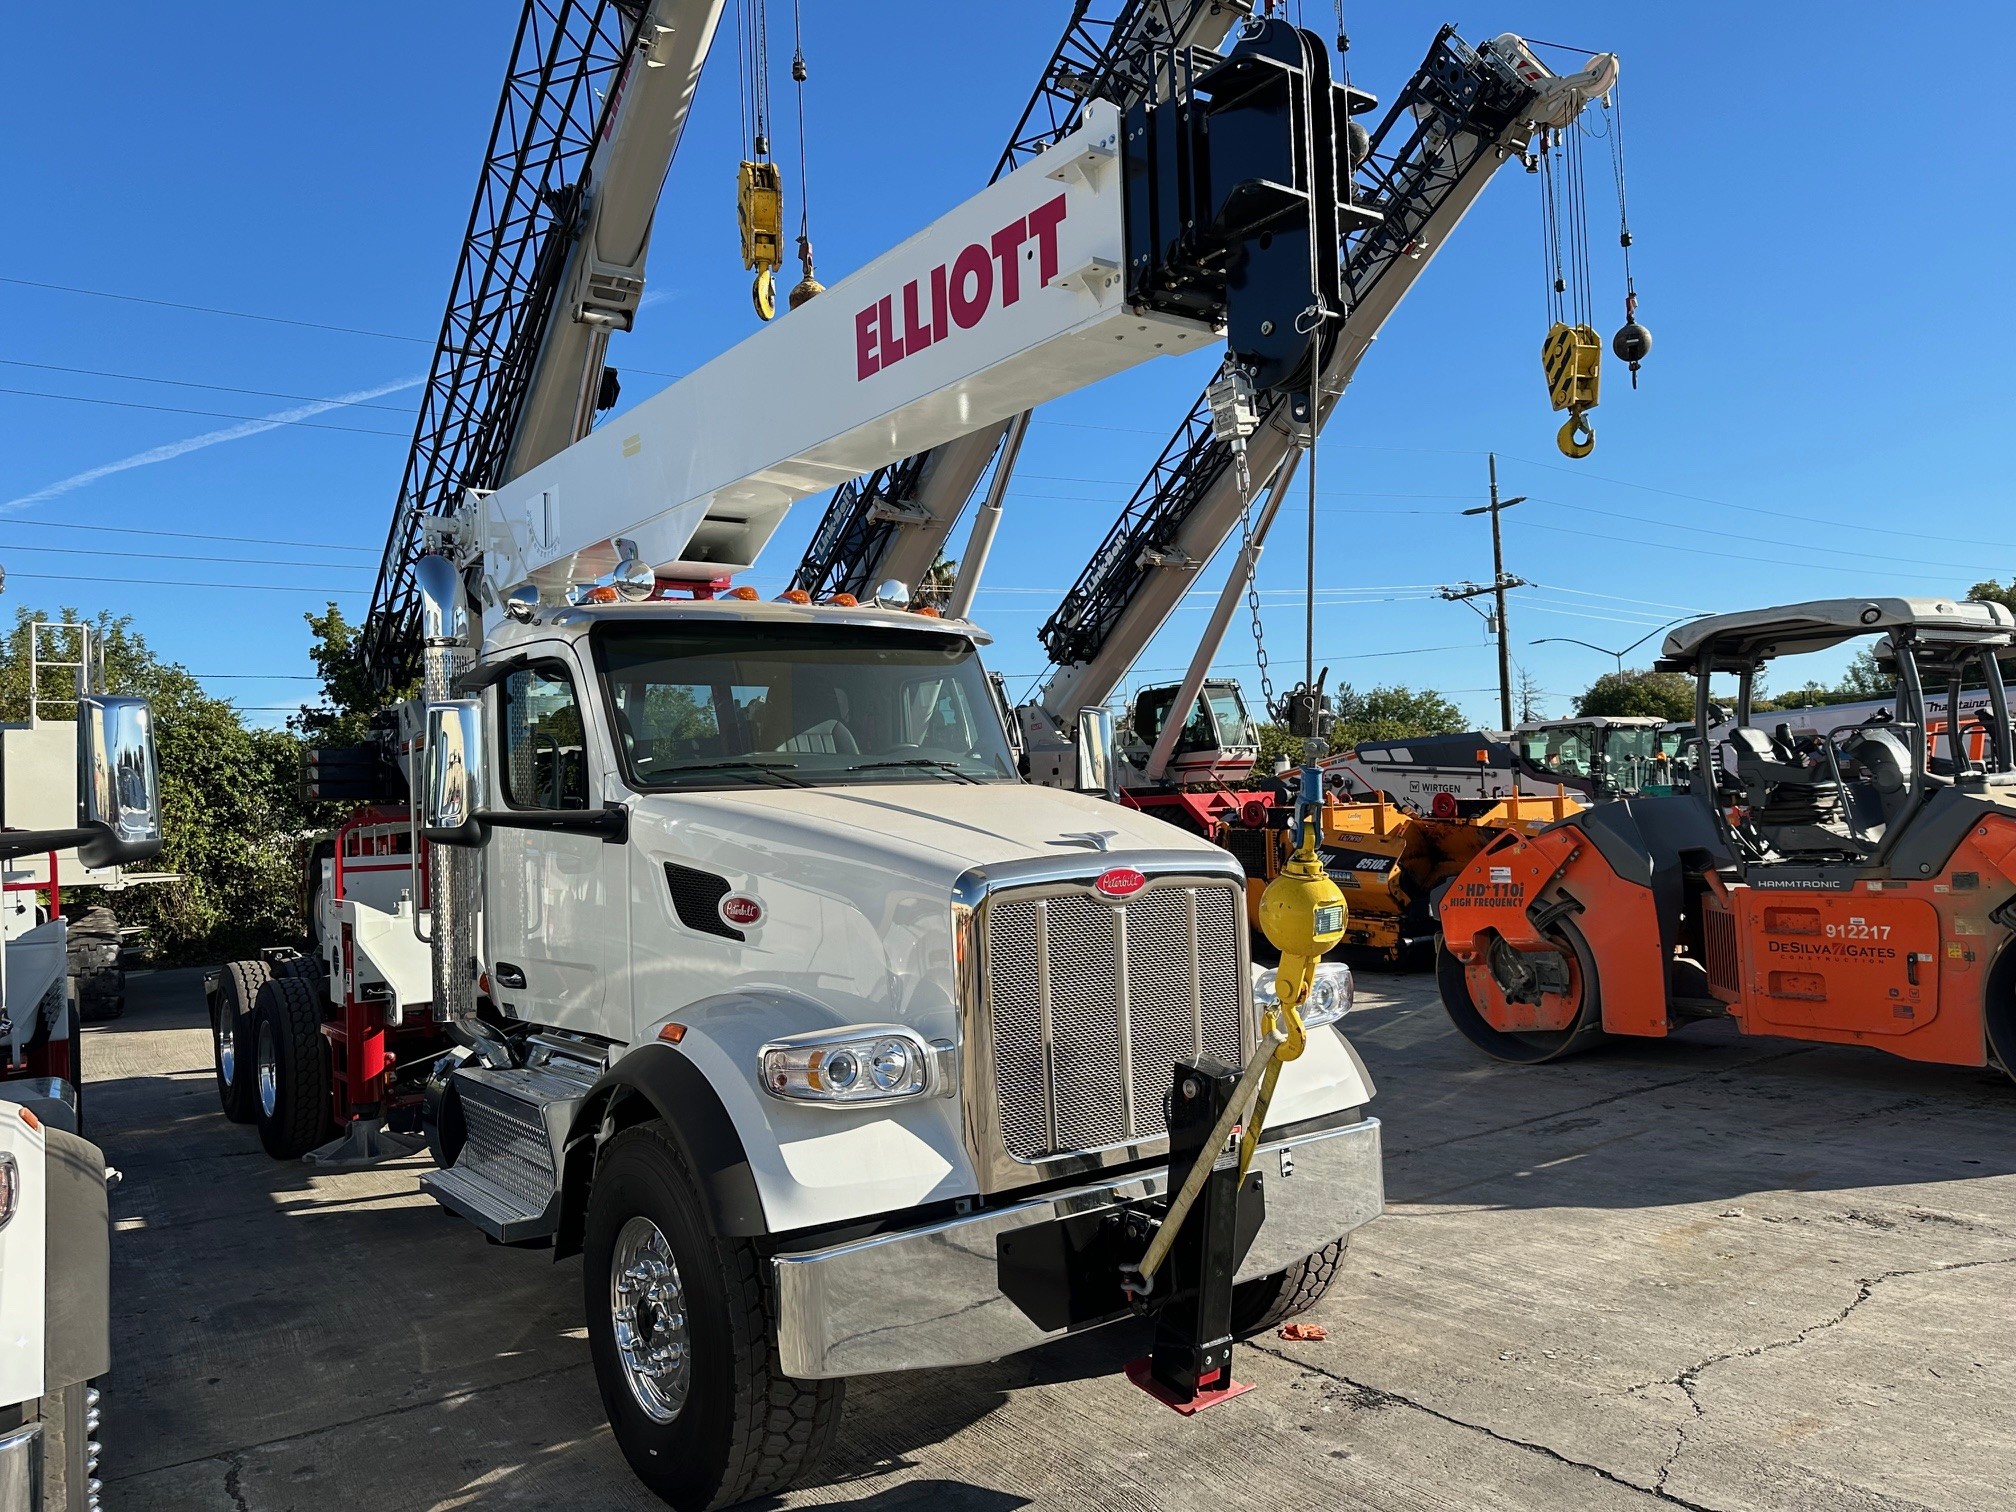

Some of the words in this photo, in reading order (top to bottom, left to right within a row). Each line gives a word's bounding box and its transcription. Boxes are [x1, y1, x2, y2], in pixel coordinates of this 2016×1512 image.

[855, 193, 1067, 383] ELLIOTT
[817, 488, 853, 555] Link-Belt
[1086, 534, 1126, 593] Link-Belt
[1421, 783, 1461, 793] WIRTGEN
[1356, 857, 1390, 870] 8510E
[1102, 873, 1142, 890] Peterbilt
[1758, 880, 1841, 888] HAMMTRONIC
[726, 901, 758, 917] Peterbilt
[1450, 897, 1471, 907] HIGH
[1474, 897, 1524, 908] FREQUENCY
[1825, 924, 1891, 940] 912217
[1780, 955, 1885, 964] CONSTRUCTION
